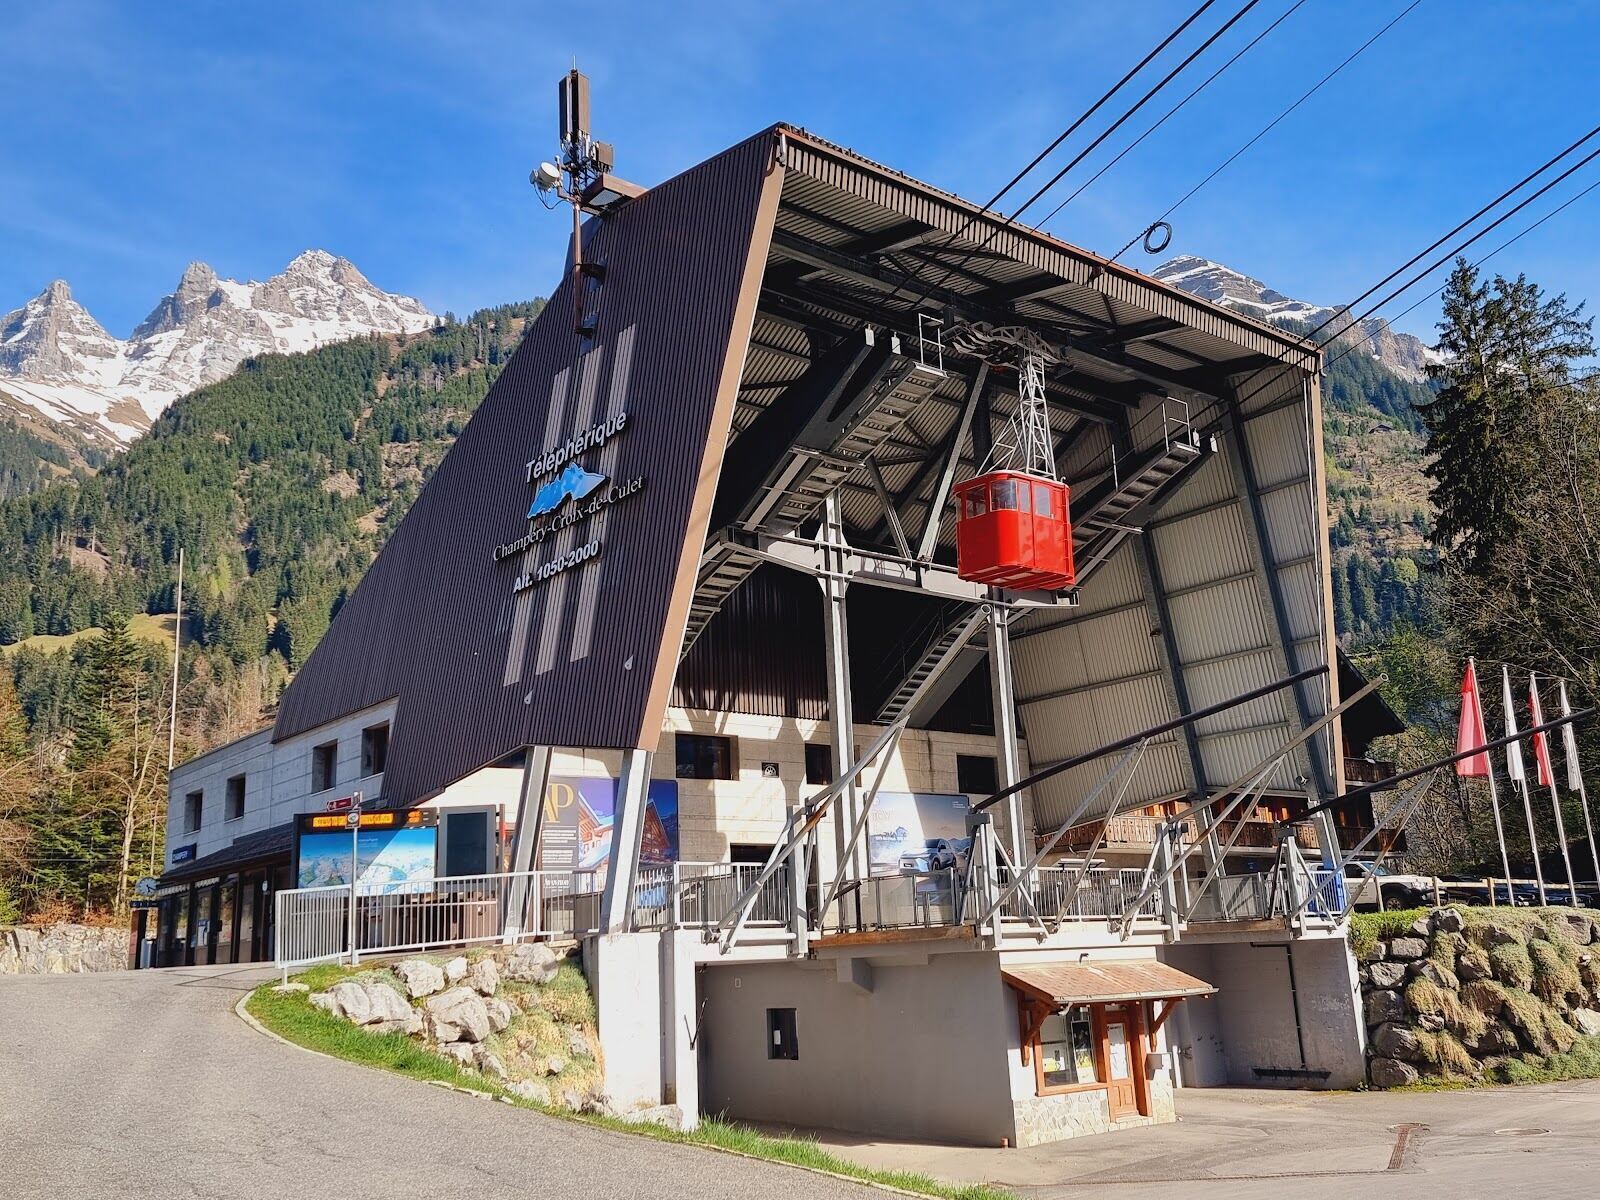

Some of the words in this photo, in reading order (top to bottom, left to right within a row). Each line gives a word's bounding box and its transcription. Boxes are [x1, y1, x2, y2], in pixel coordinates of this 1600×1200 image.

[525, 412, 627, 483] Téléphérique
[513, 573, 533, 593] Alt.
[537, 540, 600, 580] 1050-2000
